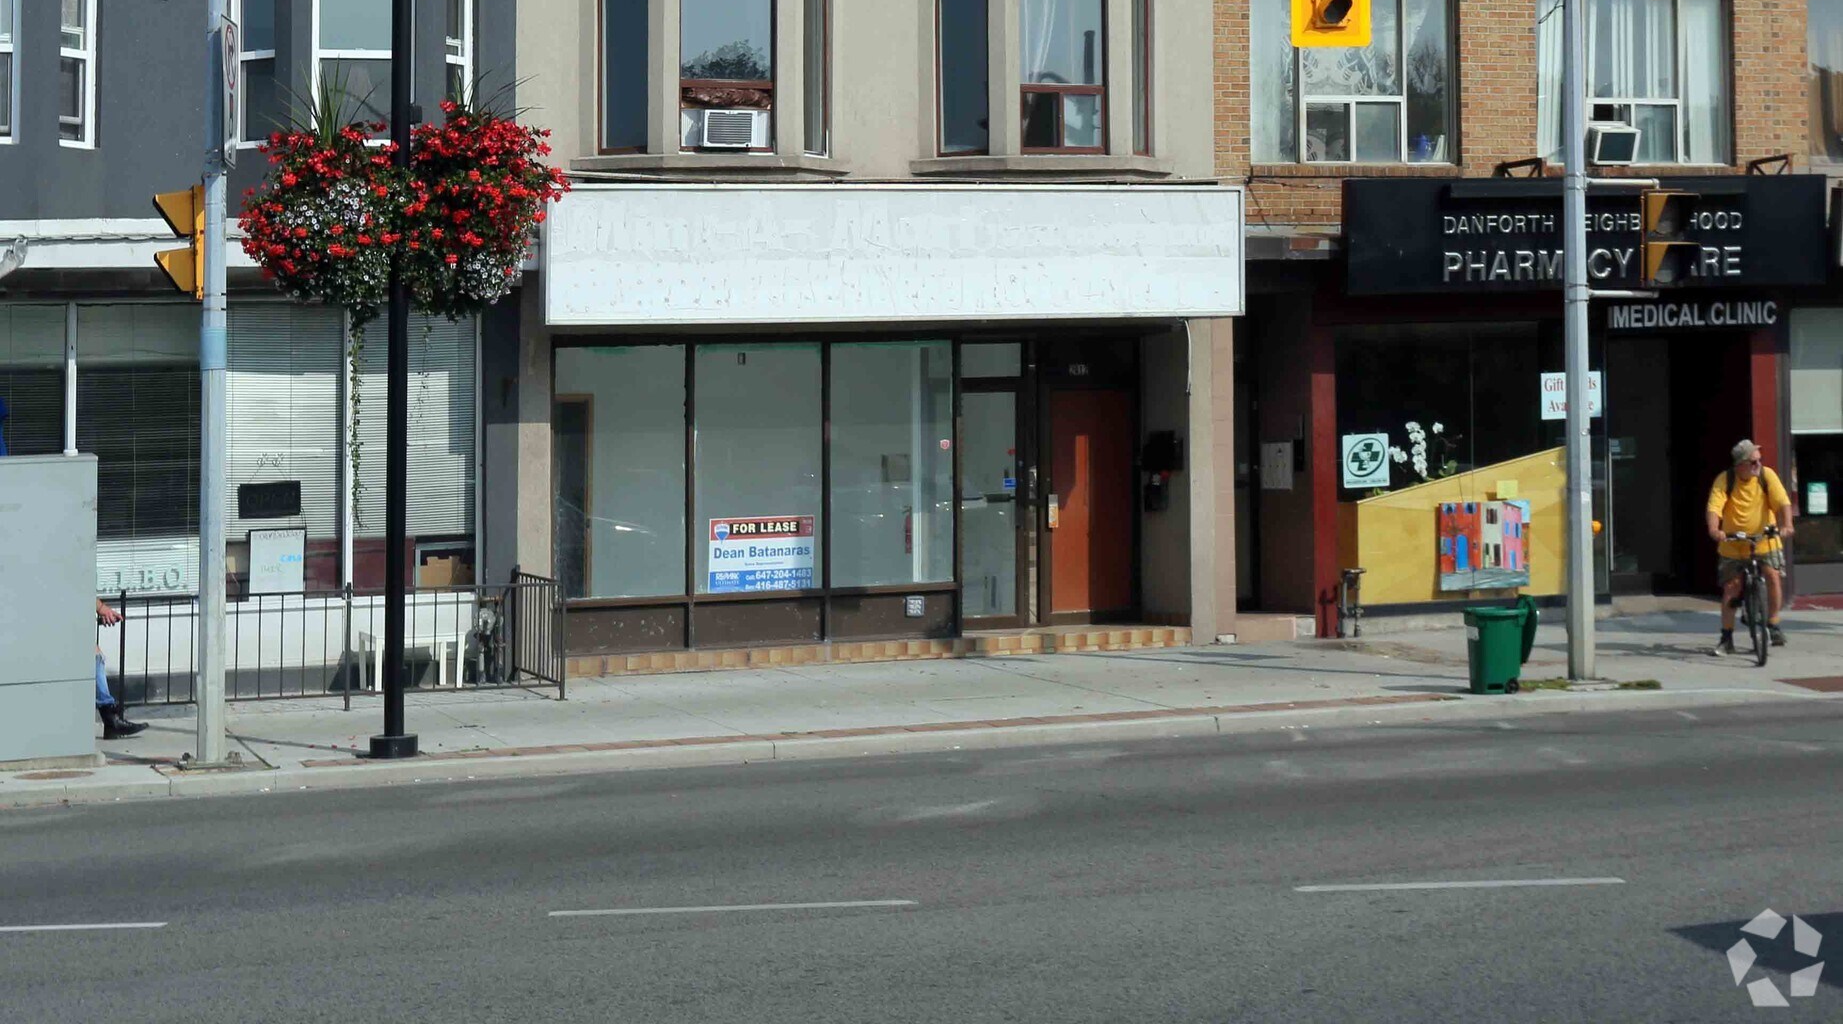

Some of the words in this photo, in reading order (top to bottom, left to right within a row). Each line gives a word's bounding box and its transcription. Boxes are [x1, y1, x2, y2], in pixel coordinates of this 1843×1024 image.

[1443, 215, 1555, 234] DANFORTH
[1585, 212, 1742, 231] EIGHBHOOD
[1443, 247, 1634, 282] PHARMCY
[1690, 246, 1742, 276] RE
[1612, 303, 1706, 328] MEDICAL
[1711, 301, 1777, 325] CLINIC
[1544, 378, 1564, 392] Gift
[732, 523, 756, 534] FOR
[760, 521, 797, 533] LEASE
[713, 547, 745, 559] Dean
[749, 545, 810, 558] Batanaras
